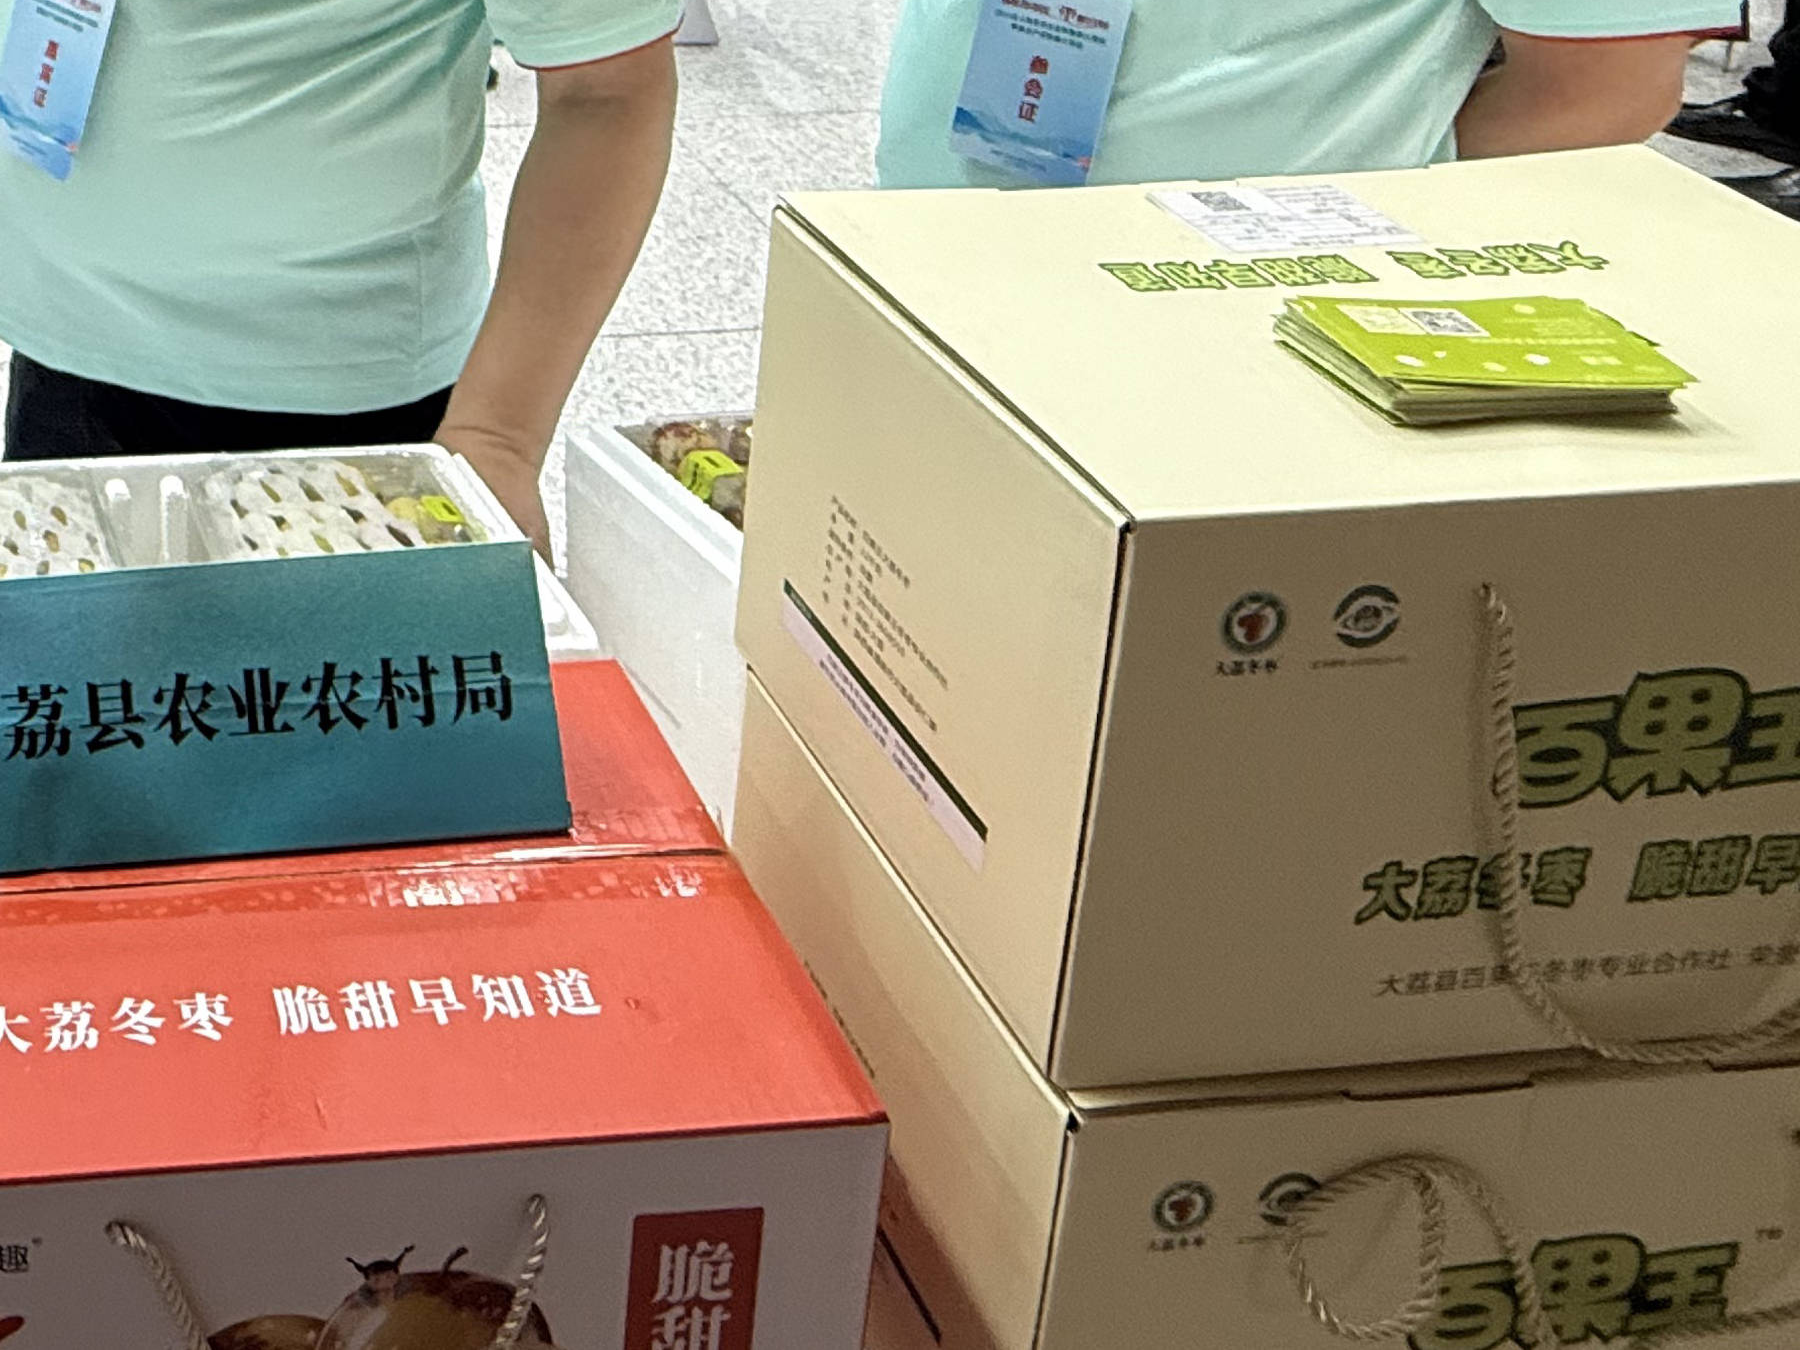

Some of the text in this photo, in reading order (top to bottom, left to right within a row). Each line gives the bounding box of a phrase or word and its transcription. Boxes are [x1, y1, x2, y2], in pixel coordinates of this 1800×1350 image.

[273, 967, 604, 1040] 脆甜早知道
